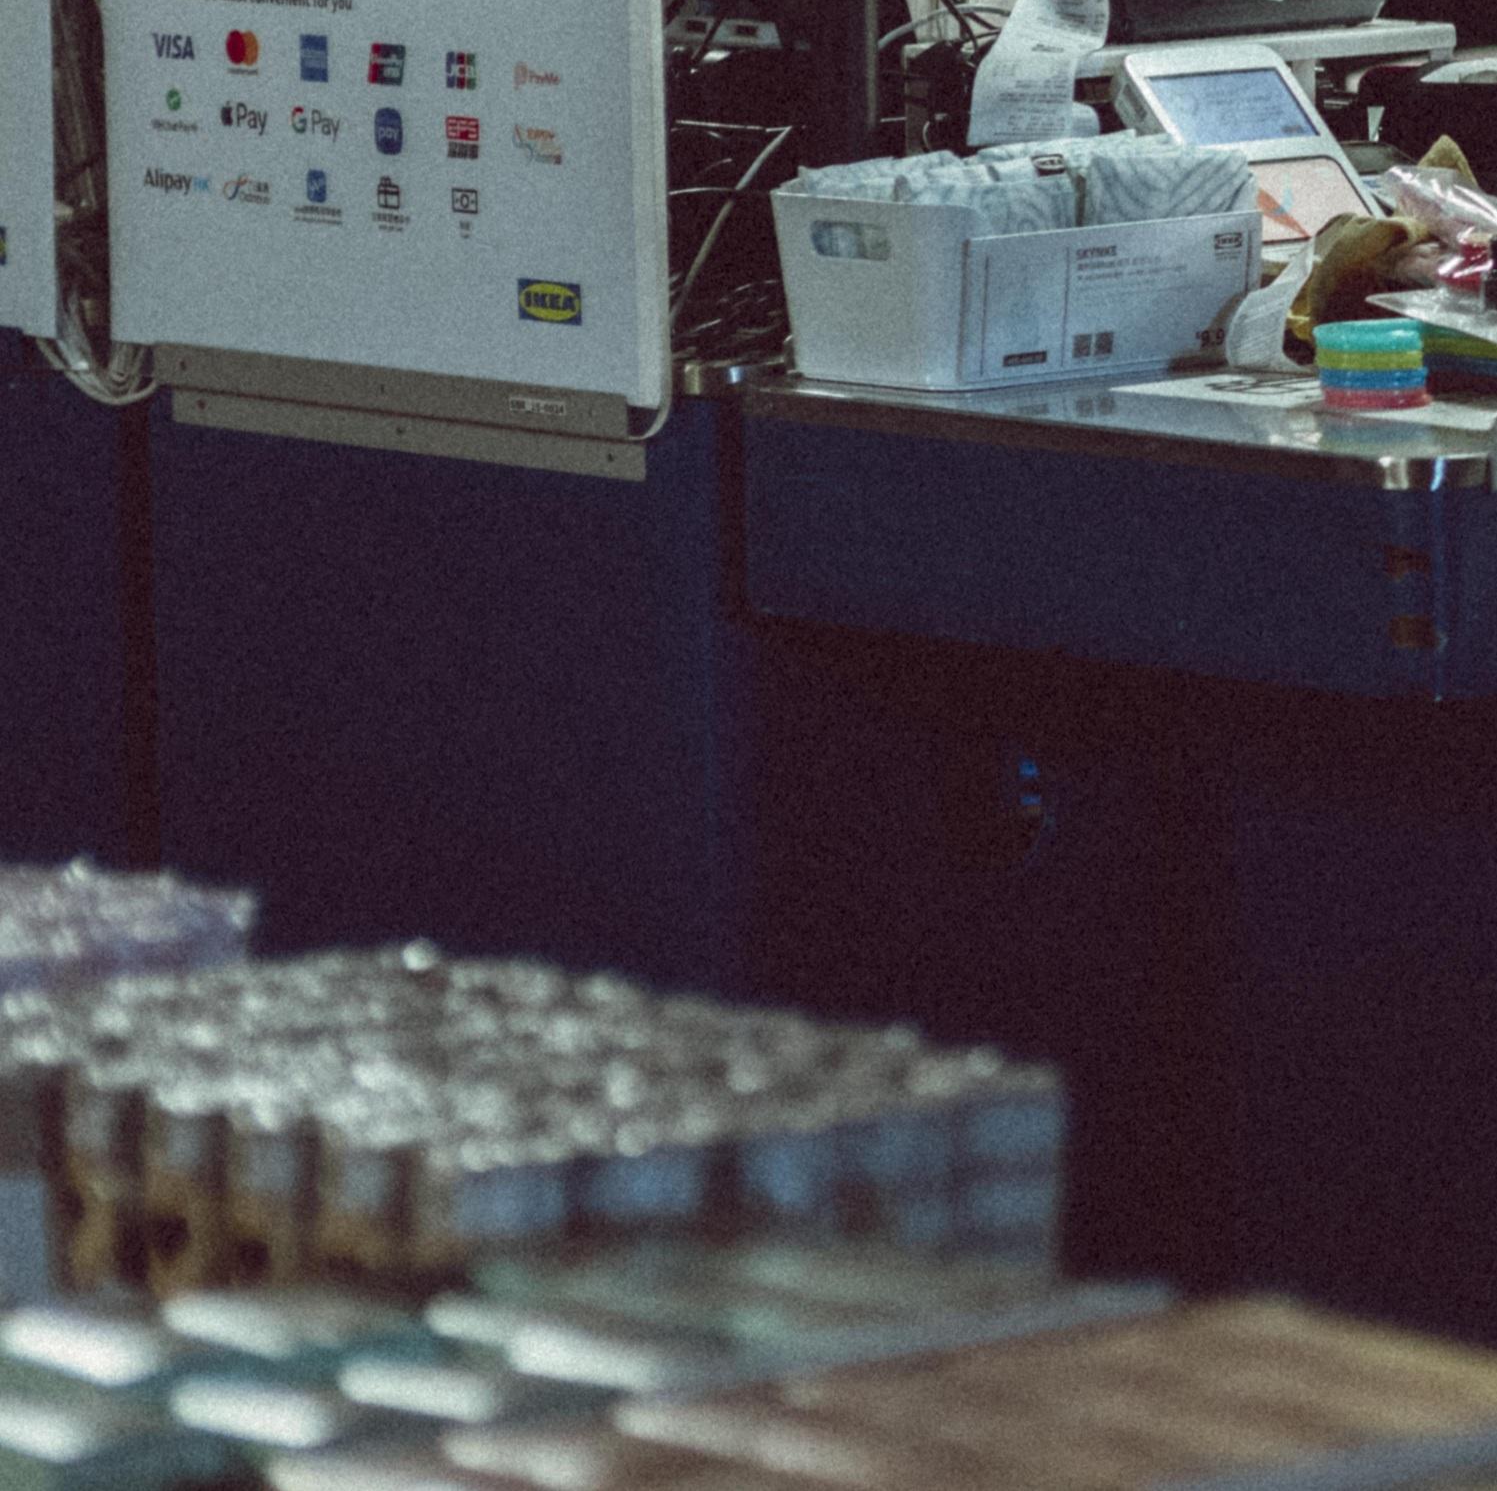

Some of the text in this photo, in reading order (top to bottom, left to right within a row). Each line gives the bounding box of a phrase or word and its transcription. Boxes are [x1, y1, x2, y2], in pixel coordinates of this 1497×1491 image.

[152, 32, 196, 60] VISA
[236, 102, 268, 136] Pay
[311, 108, 341, 143] Pay
[524, 291, 578, 312] IKEA
